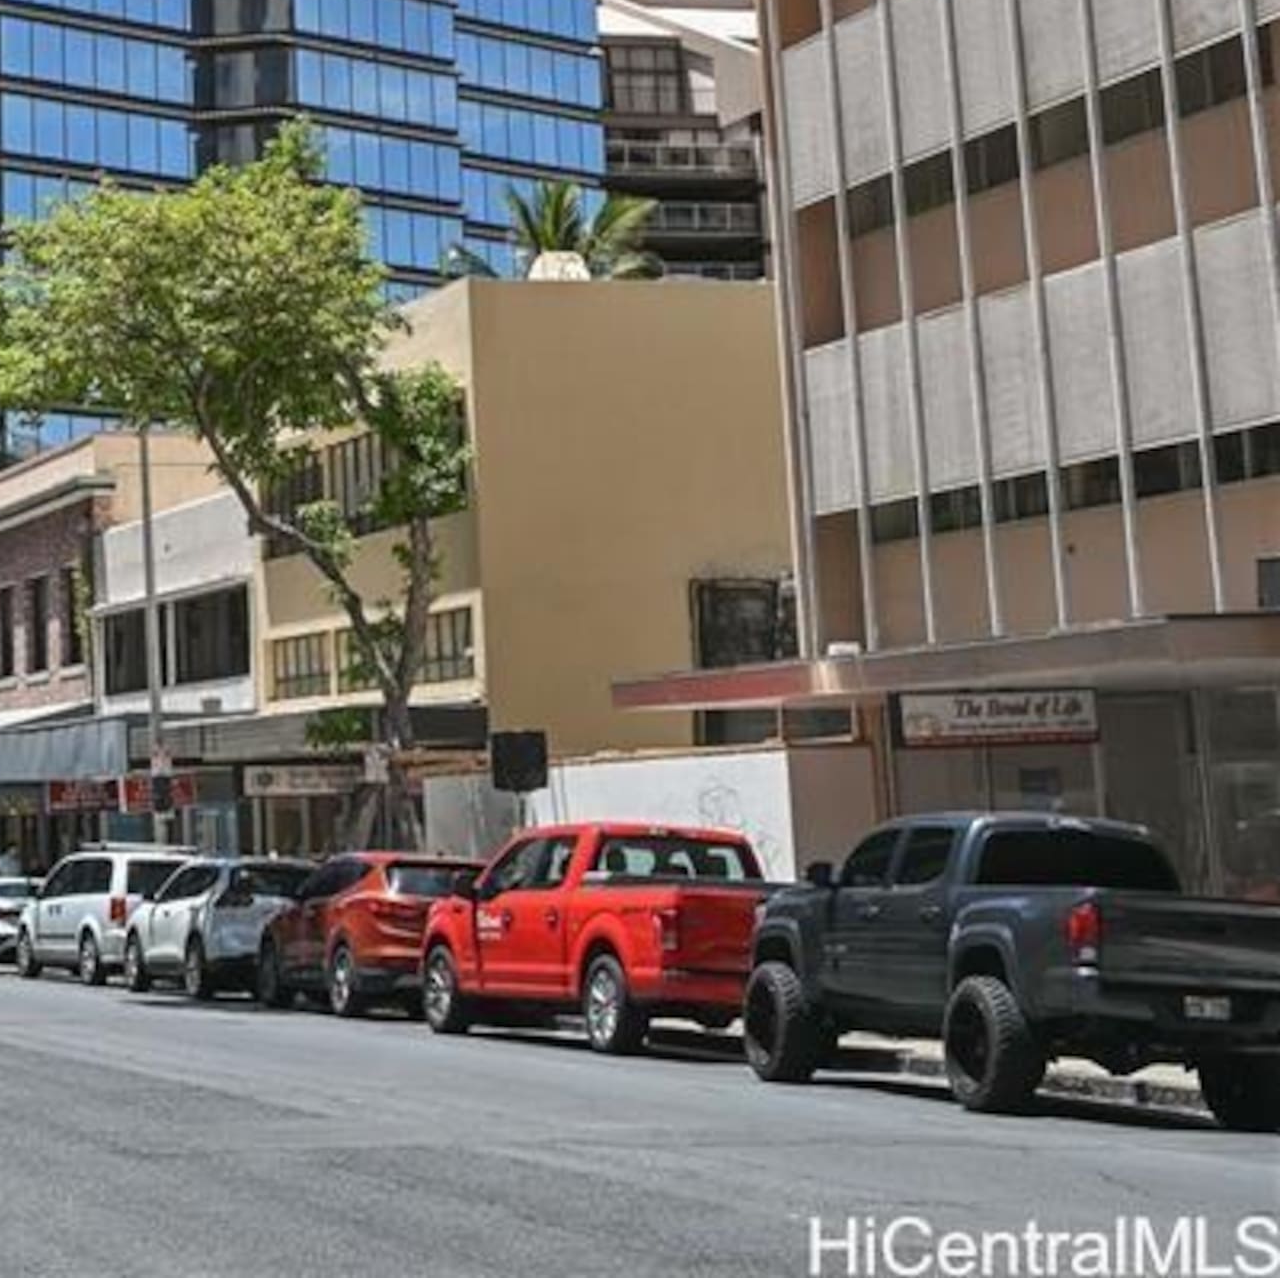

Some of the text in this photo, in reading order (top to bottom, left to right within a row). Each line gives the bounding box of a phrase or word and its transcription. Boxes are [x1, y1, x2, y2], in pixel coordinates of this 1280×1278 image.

[954, 698, 983, 718] The
[1034, 696, 1048, 718] of
[1051, 695, 1083, 716] Life
